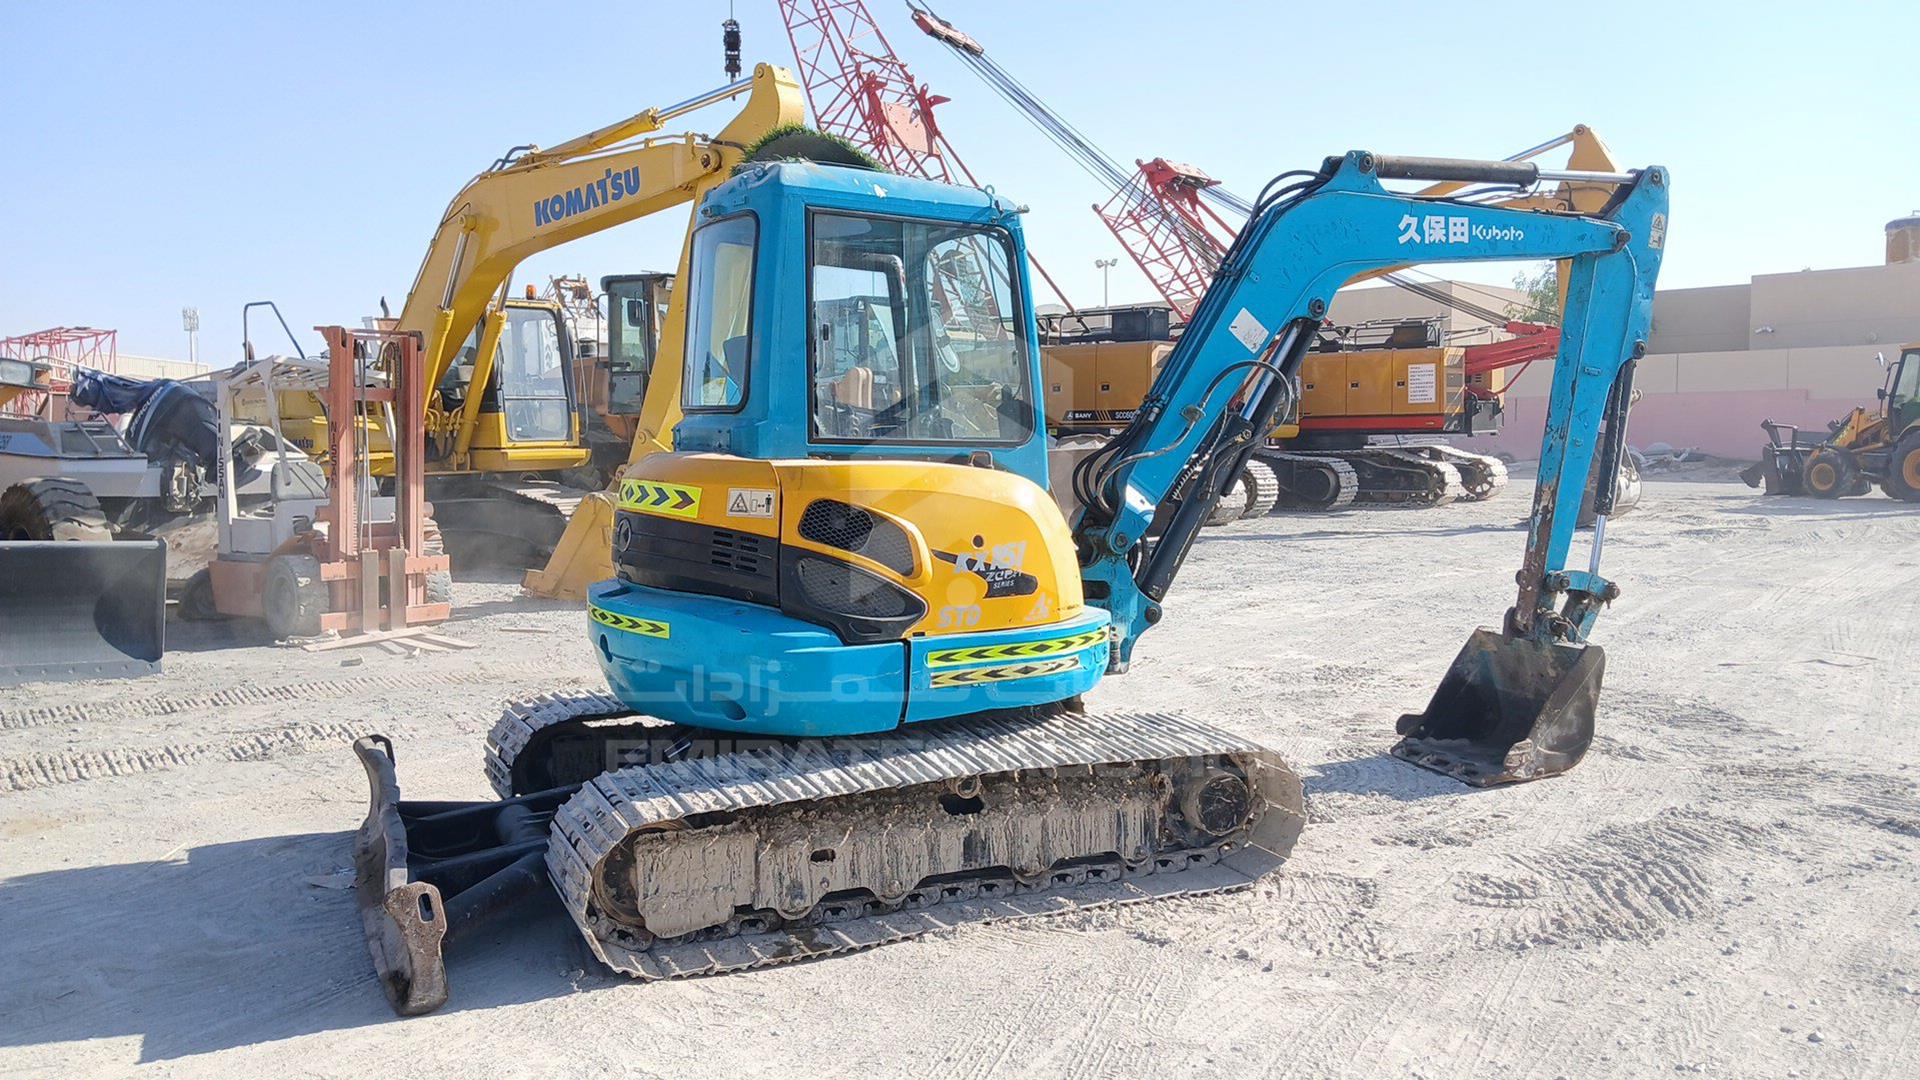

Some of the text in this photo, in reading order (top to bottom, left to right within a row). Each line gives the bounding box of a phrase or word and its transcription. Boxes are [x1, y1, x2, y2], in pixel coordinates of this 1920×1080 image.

[534, 166, 641, 227] KOMATSU
[1397, 214, 1524, 245] 久保田 Kubota
[217, 437, 225, 499] NISSAN
